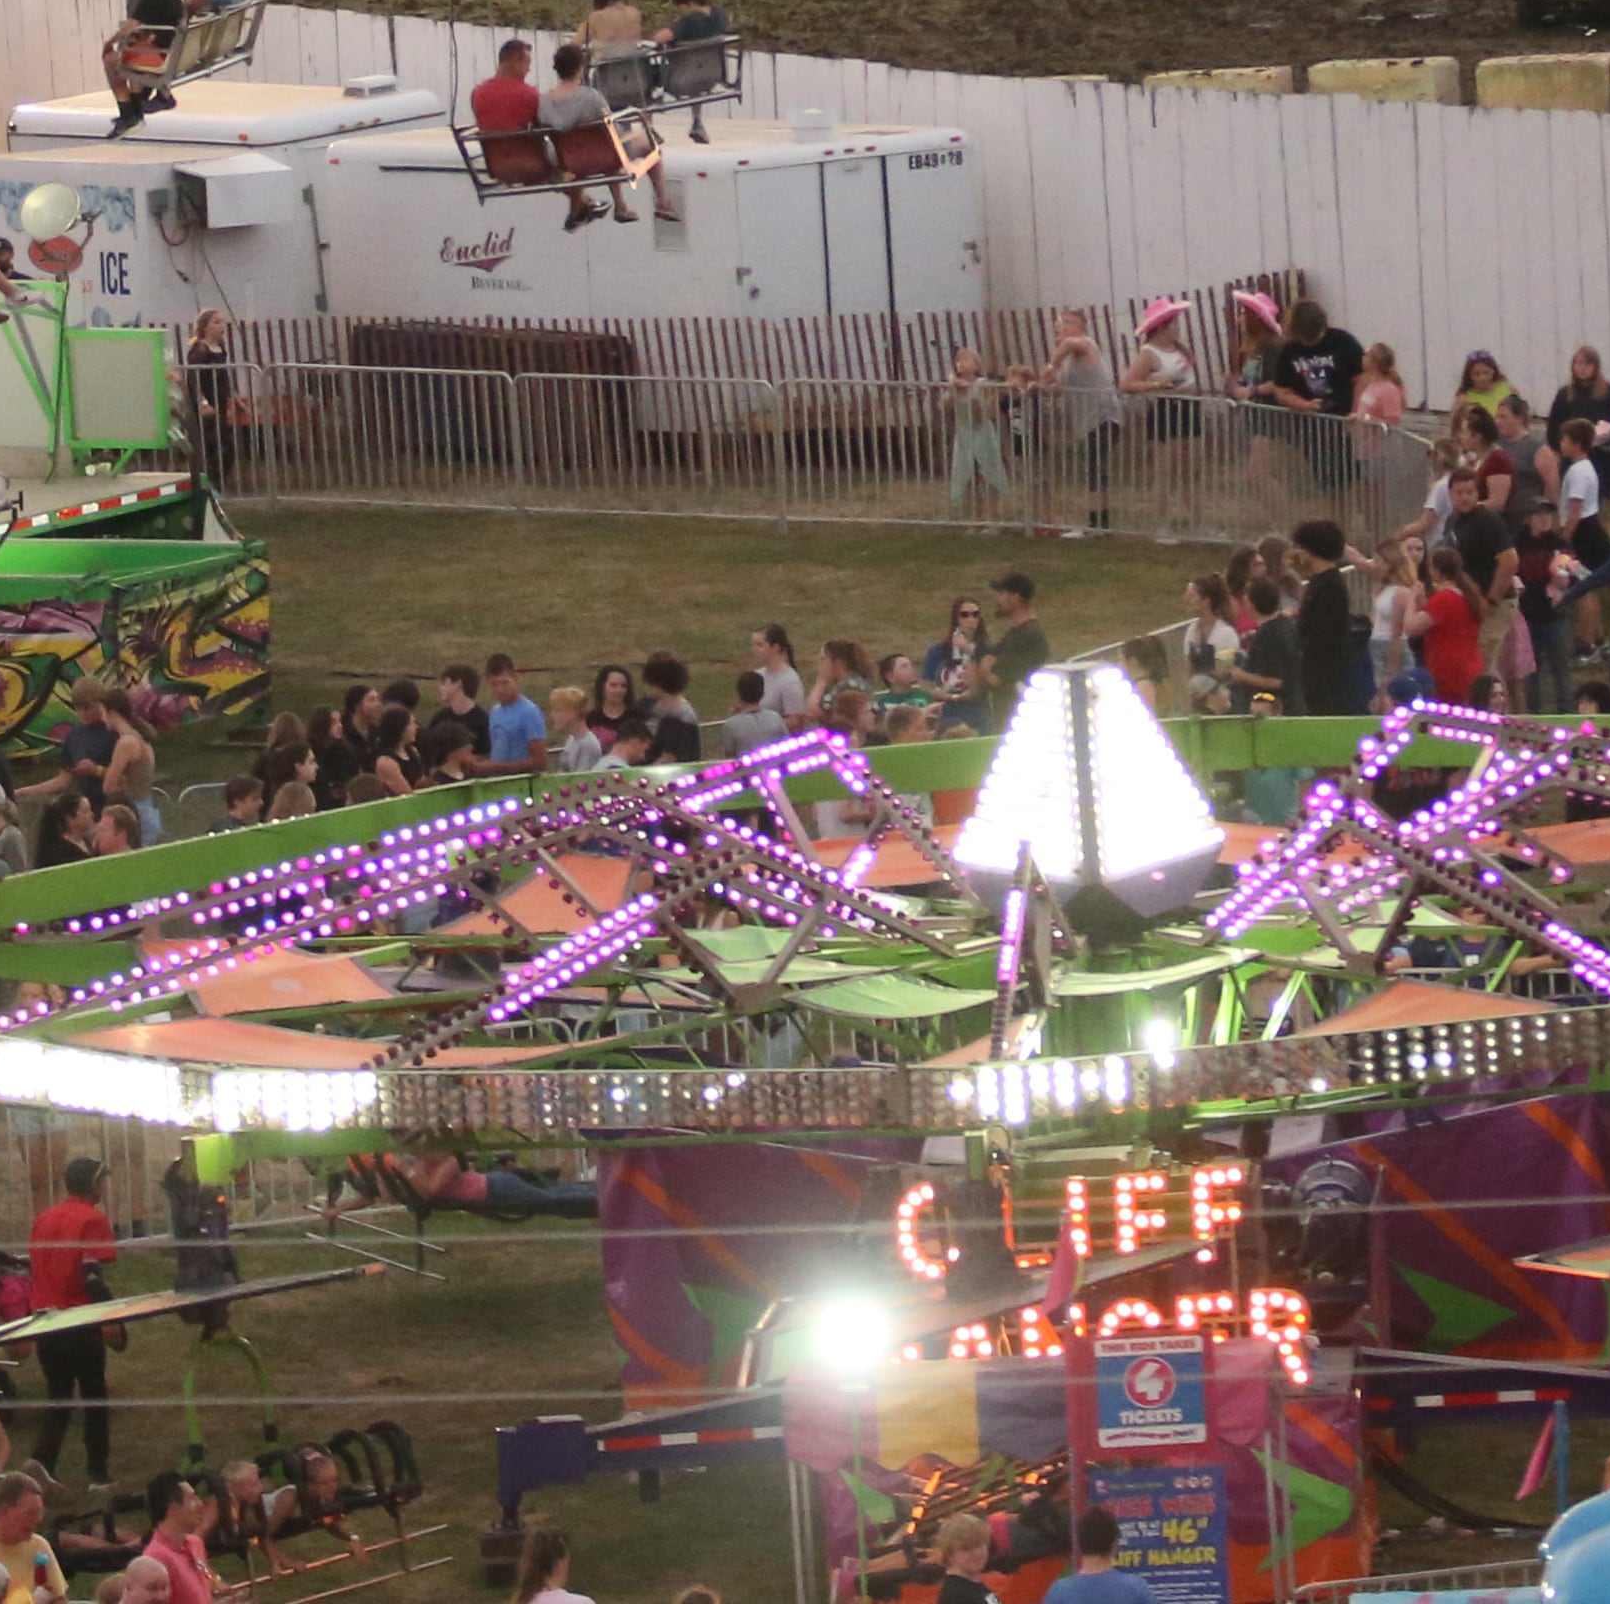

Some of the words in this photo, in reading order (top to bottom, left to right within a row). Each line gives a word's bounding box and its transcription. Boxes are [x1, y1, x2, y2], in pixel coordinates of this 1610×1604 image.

[440, 227, 515, 263] Euclid
[100, 251, 131, 295] ICE
[1135, 1362, 1165, 1400] 4
[1109, 1408, 1184, 1426] TICKETS
[1111, 1550, 1142, 1567] LIFF
[1147, 1546, 1217, 1566] HANGER
